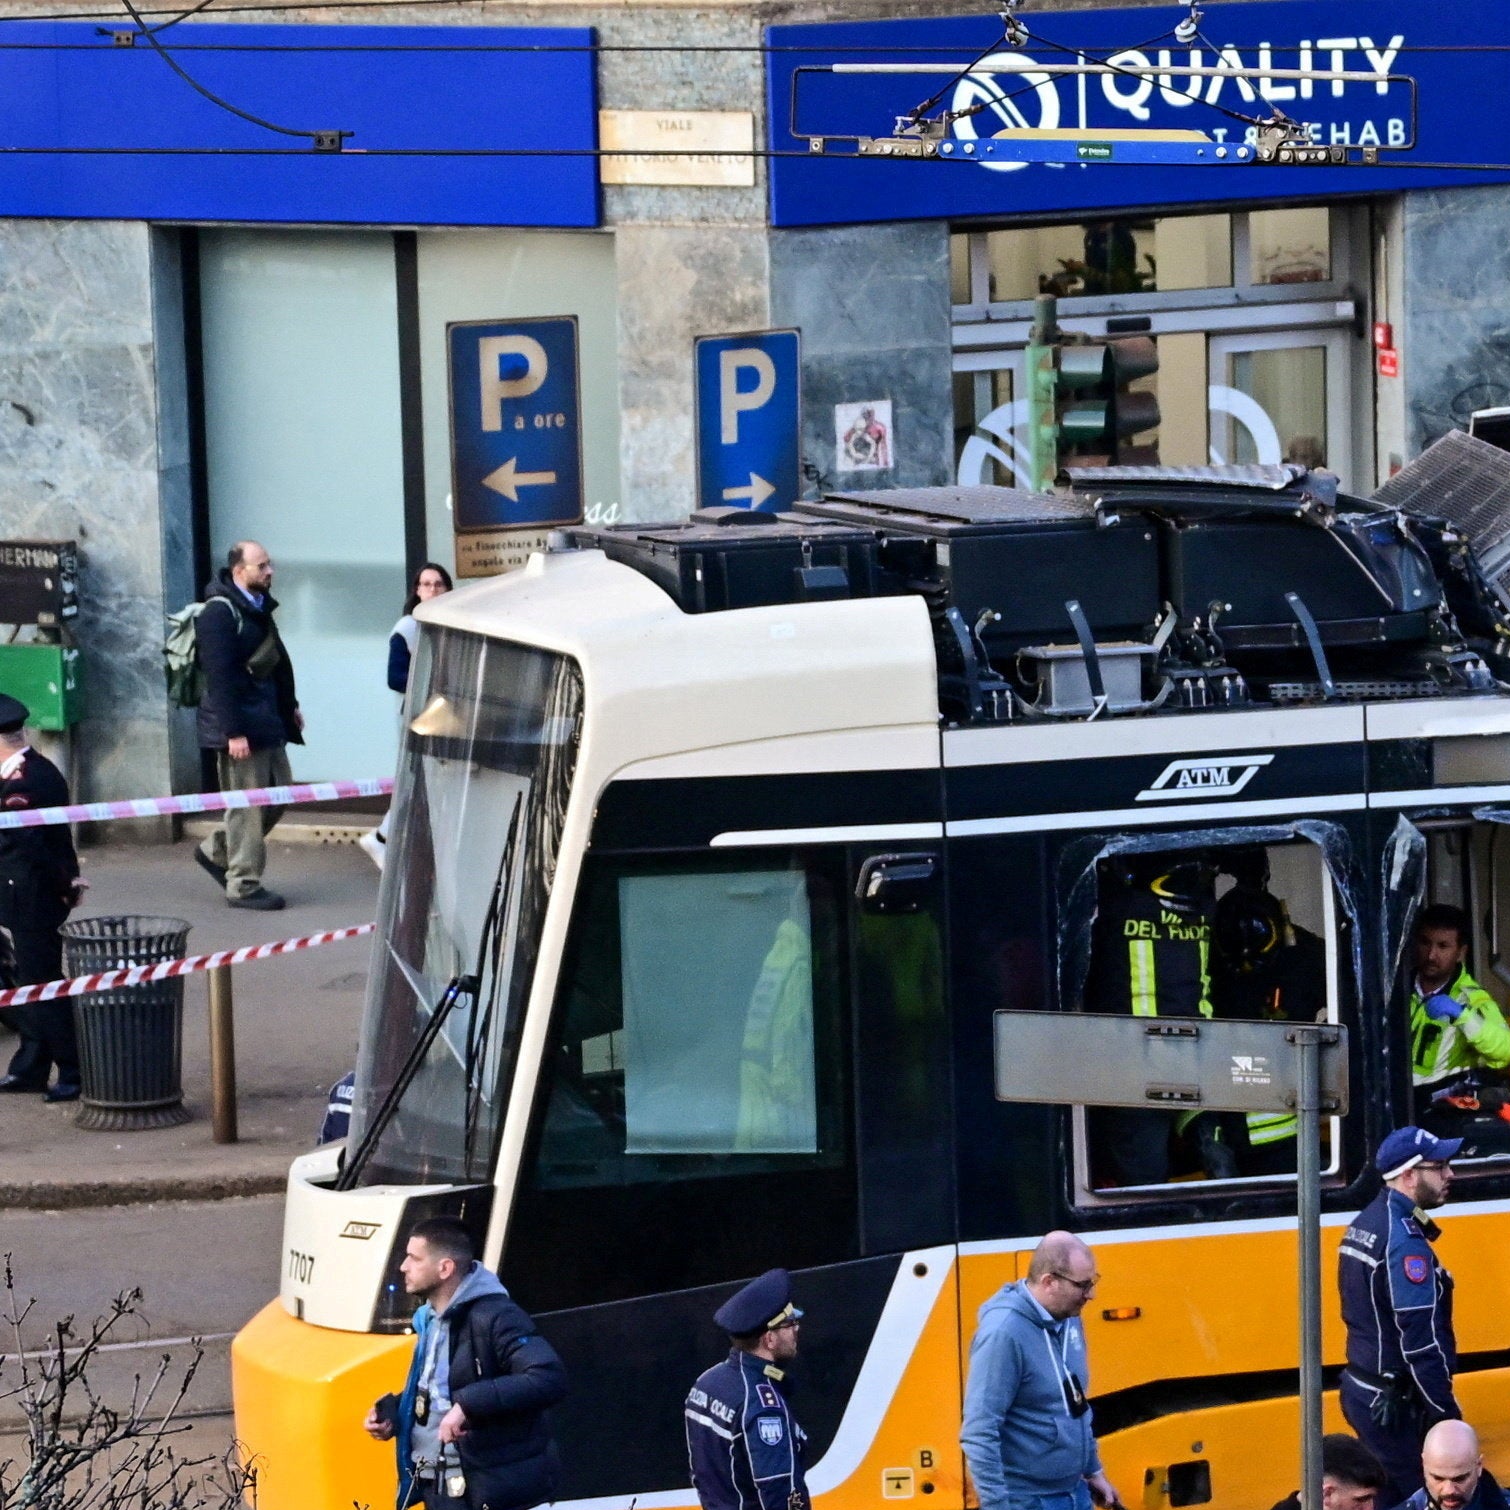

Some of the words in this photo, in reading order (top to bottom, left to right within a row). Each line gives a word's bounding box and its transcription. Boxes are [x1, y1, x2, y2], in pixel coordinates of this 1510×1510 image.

[1101, 35, 1404, 120] QUALITY
[656, 119, 693, 131] VIALE
[1306, 118, 1406, 147] EHAB
[479, 334, 549, 432] P
[719, 347, 777, 445] P
[533, 411, 566, 429] ore
[1176, 766, 1232, 789] ATM
[1123, 919, 1162, 939] DEL
[289, 1248, 316, 1285] 7707
[920, 1449, 934, 1468] B
